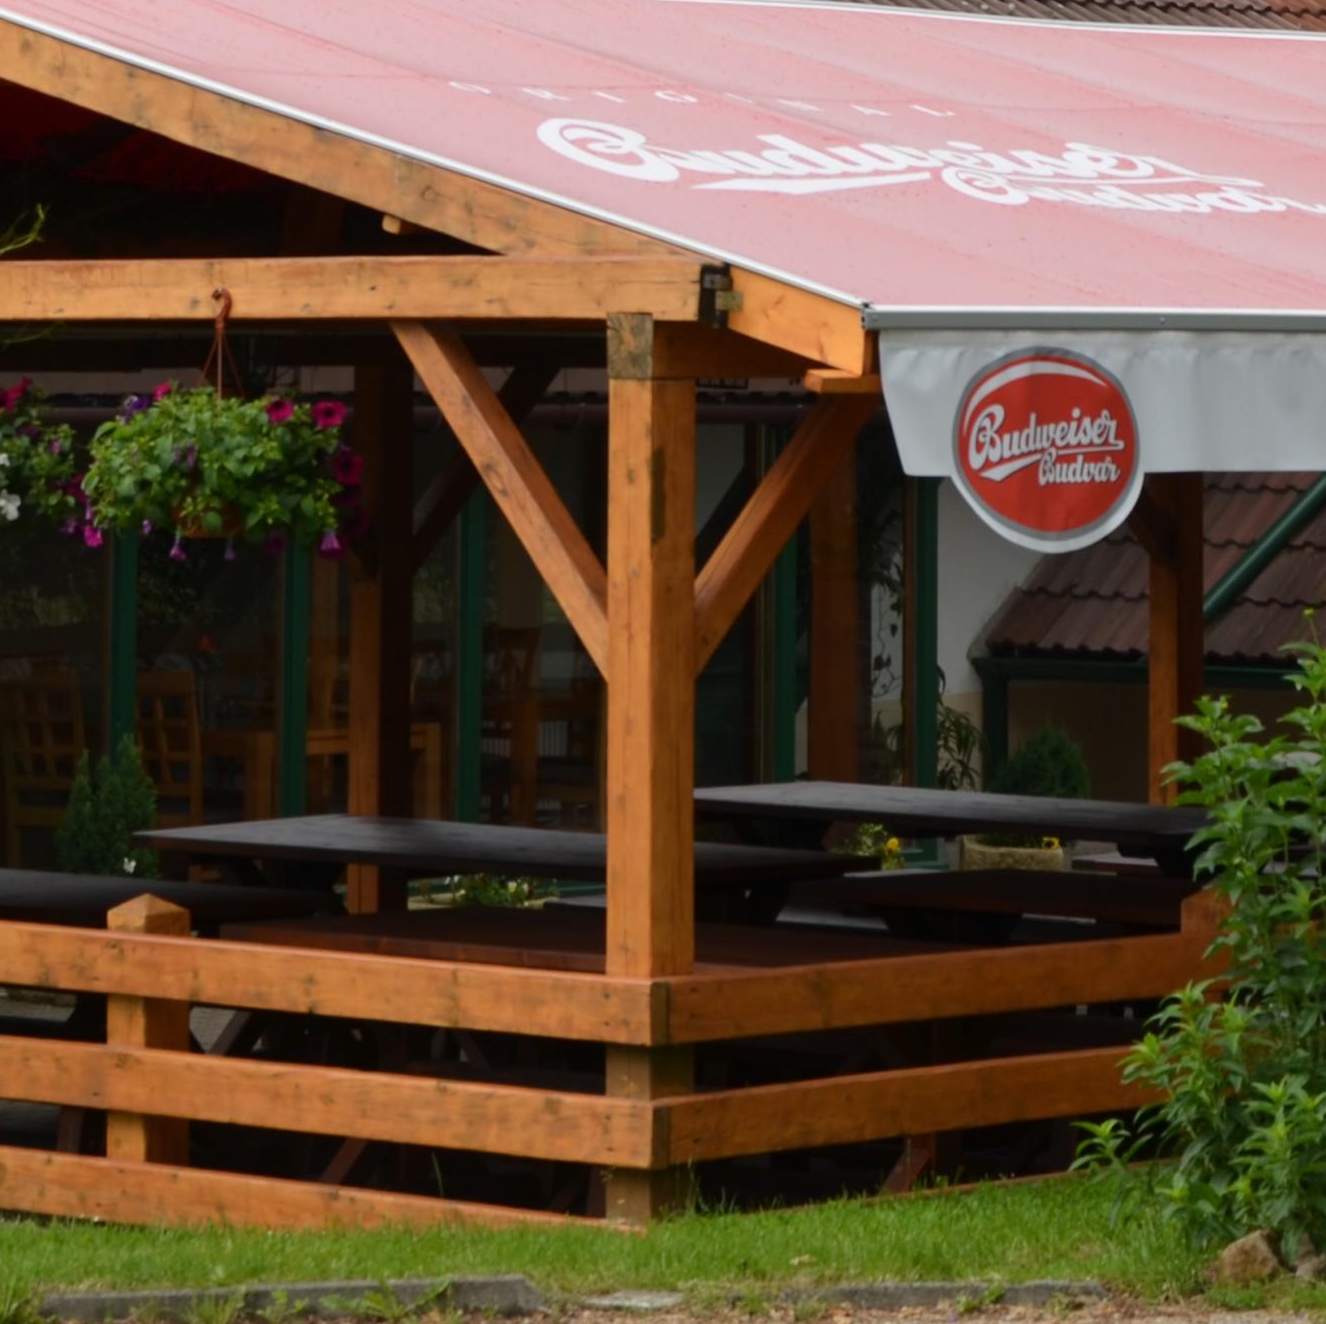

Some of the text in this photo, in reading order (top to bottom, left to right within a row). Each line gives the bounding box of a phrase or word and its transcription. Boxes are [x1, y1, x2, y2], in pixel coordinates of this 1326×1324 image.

[536, 117, 1265, 188] Budweiser
[968, 404, 1125, 471] Budweiser
[1038, 447, 1120, 486] Budvar
